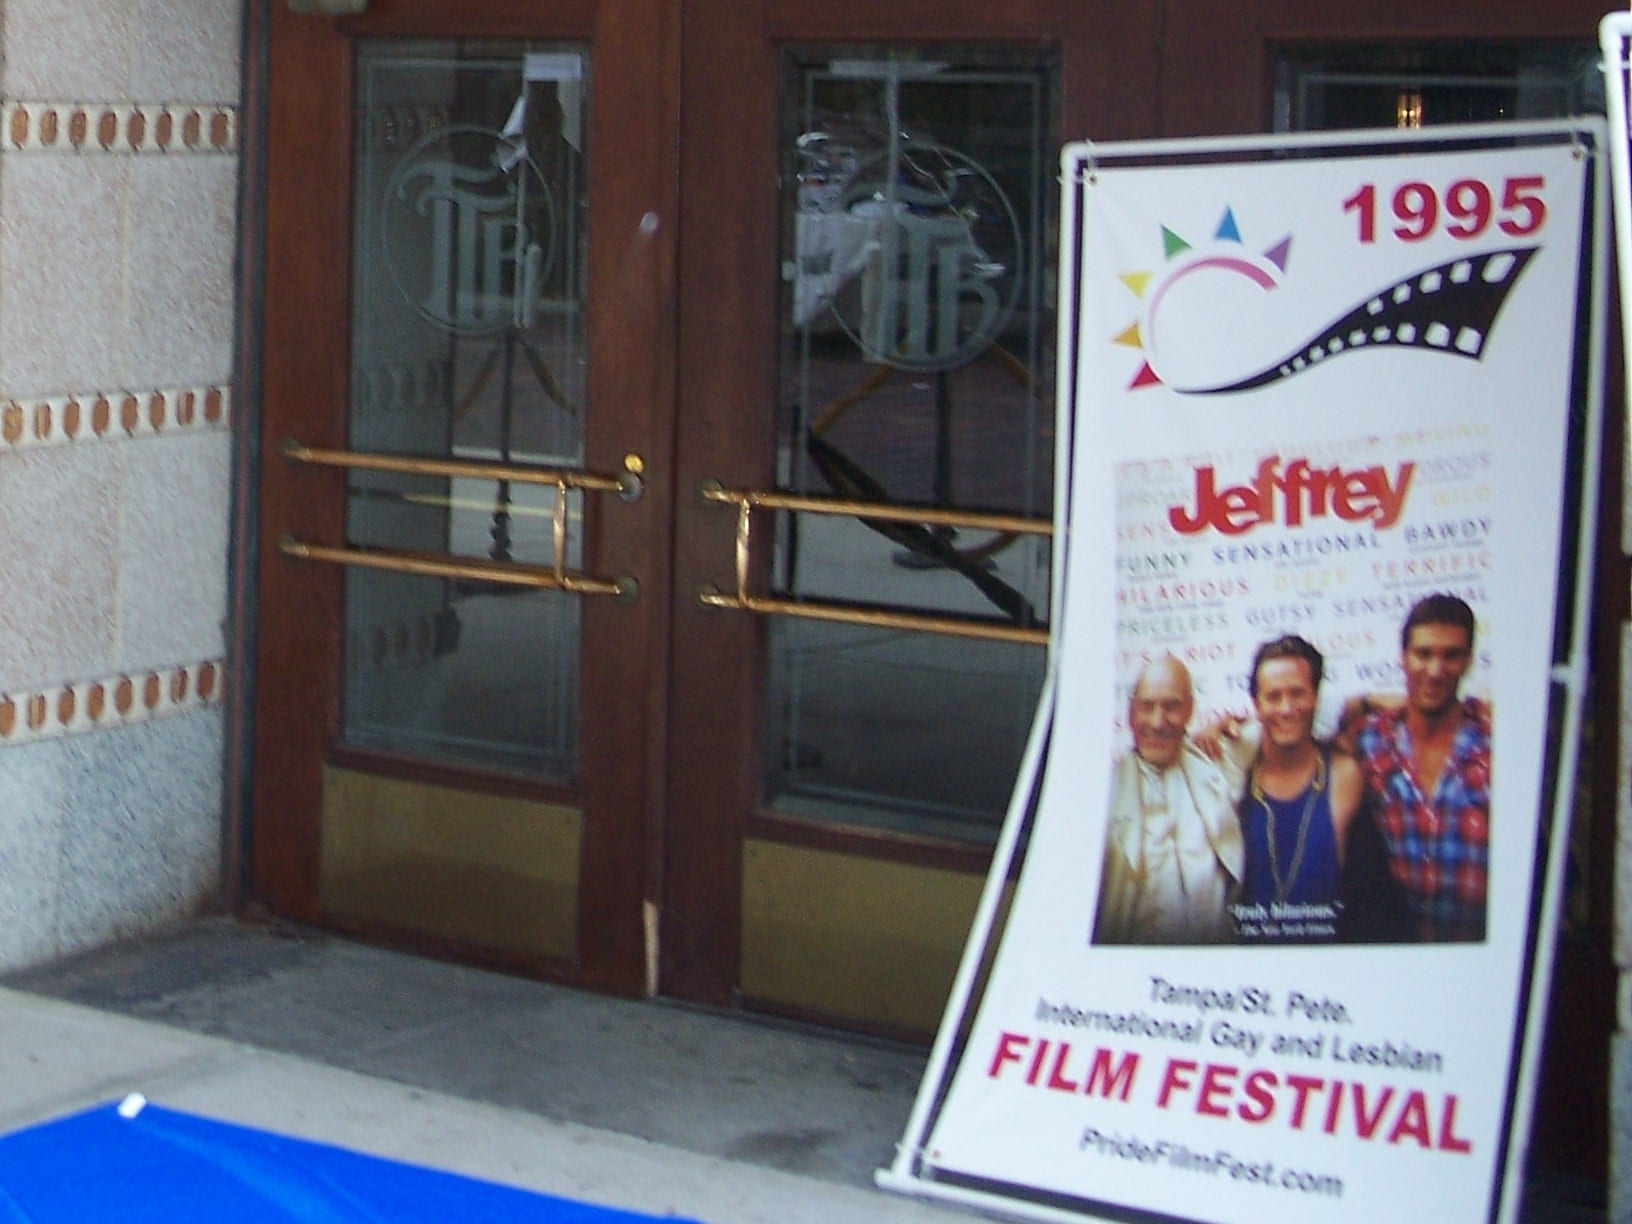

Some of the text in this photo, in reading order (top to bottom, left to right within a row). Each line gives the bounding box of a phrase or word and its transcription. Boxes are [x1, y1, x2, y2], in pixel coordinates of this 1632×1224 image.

[1341, 174, 1549, 245] 1995
[1168, 452, 1416, 538] Jeffrey
[1114, 579, 1251, 605] HILARIOUS
[1371, 551, 1493, 577] TERRIFIC
[1116, 518, 1493, 572] FUNNY SENSATIONAL BAWDY
[1244, 603, 1316, 626] GUTSY
[1035, 997, 1445, 1075] International Gay and Lesbian
[1149, 976, 1354, 1025] Tampa/St. Pete.
[987, 1031, 1474, 1155] FILM FESTIVAL
[1078, 1127, 1345, 1198] PrideFilmFest.com
